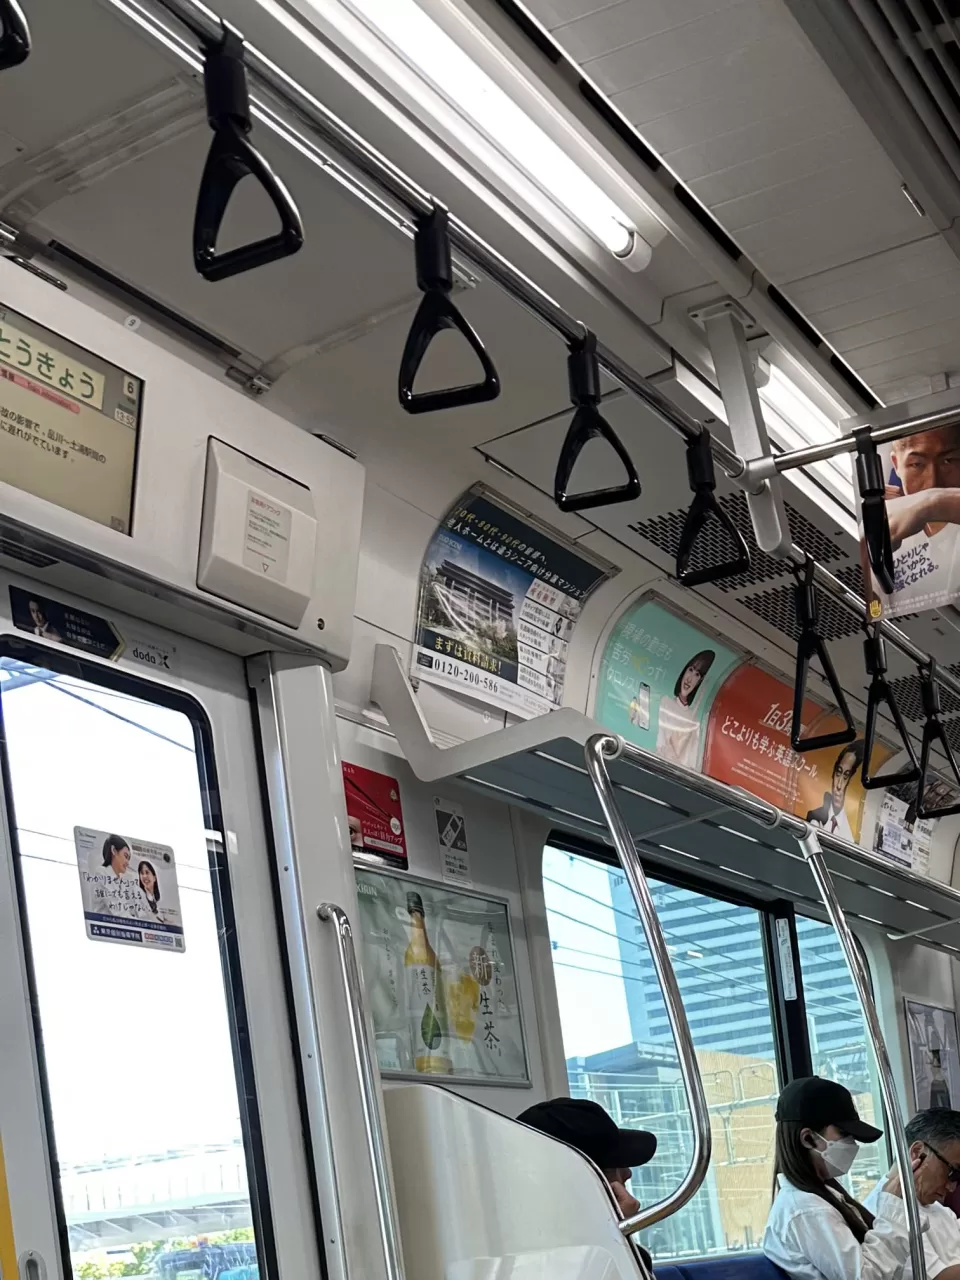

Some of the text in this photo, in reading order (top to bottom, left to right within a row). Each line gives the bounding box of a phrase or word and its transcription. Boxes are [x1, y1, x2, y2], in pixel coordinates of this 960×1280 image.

[0, 328, 94, 399] とうきょう
[126, 380, 135, 395] 6
[115, 409, 136, 427] 13:52
[434, 636, 502, 675] まずは資料請求!
[433, 658, 499, 693] 0120-200-586
[357, 884, 378, 896] KIRIN
[471, 953, 489, 981] 新
[479, 991, 500, 1051] 生茶
